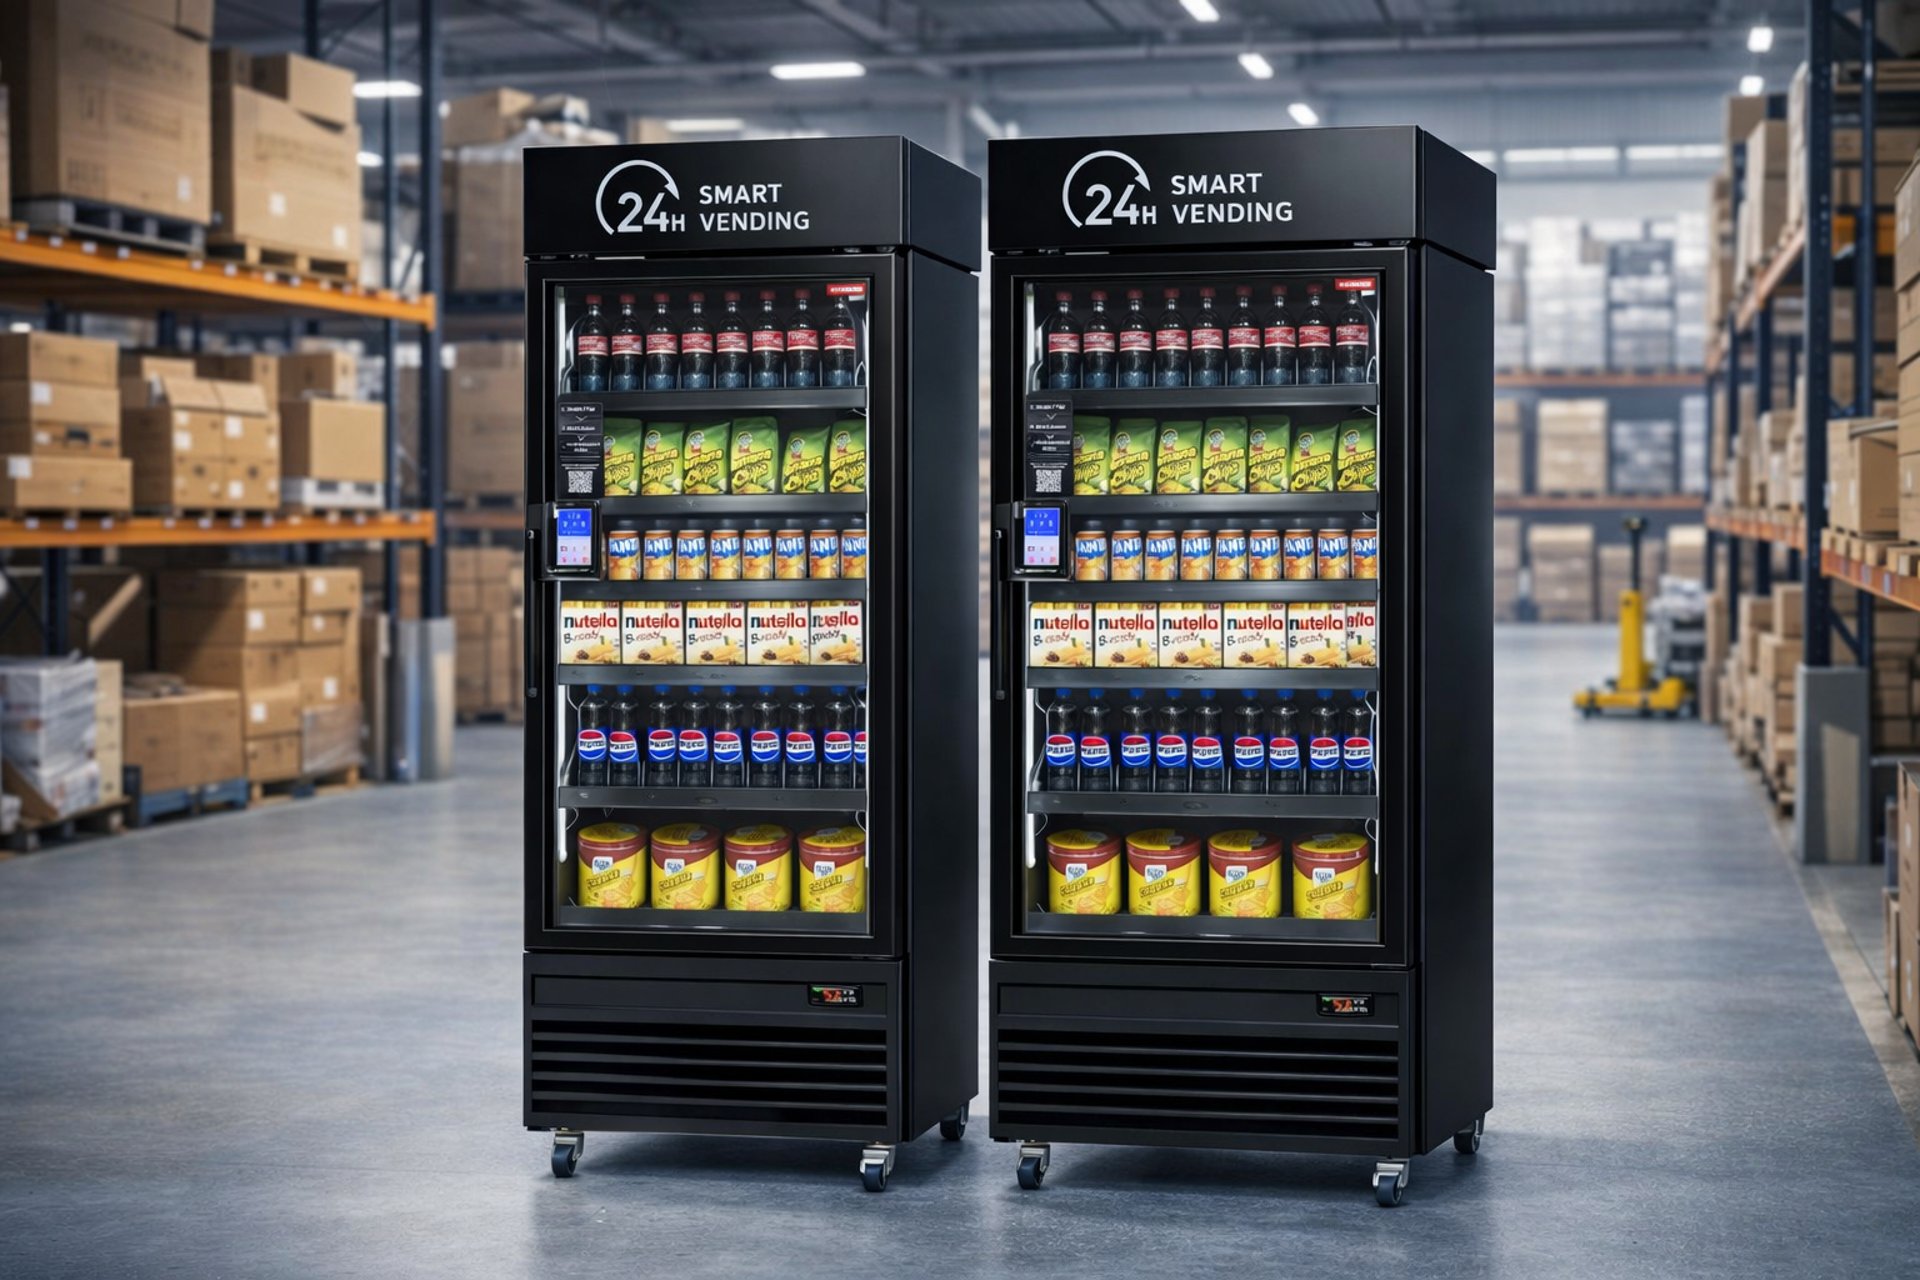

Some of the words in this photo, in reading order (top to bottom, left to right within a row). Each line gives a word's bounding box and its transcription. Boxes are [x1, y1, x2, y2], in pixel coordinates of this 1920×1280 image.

[699, 183, 783, 205] SMART
[1170, 172, 1263, 196] SMART
[617, 191, 686, 233] 24H
[1084, 183, 1157, 226] 24H
[1171, 201, 1293, 225] VENDING
[699, 210, 811, 232] VENDING
[1034, 613, 1090, 630] nutella
[1098, 613, 1155, 630] nutella
[1162, 613, 1219, 630] nutella
[1227, 613, 1284, 630] nutella
[1289, 613, 1344, 630] nutella
